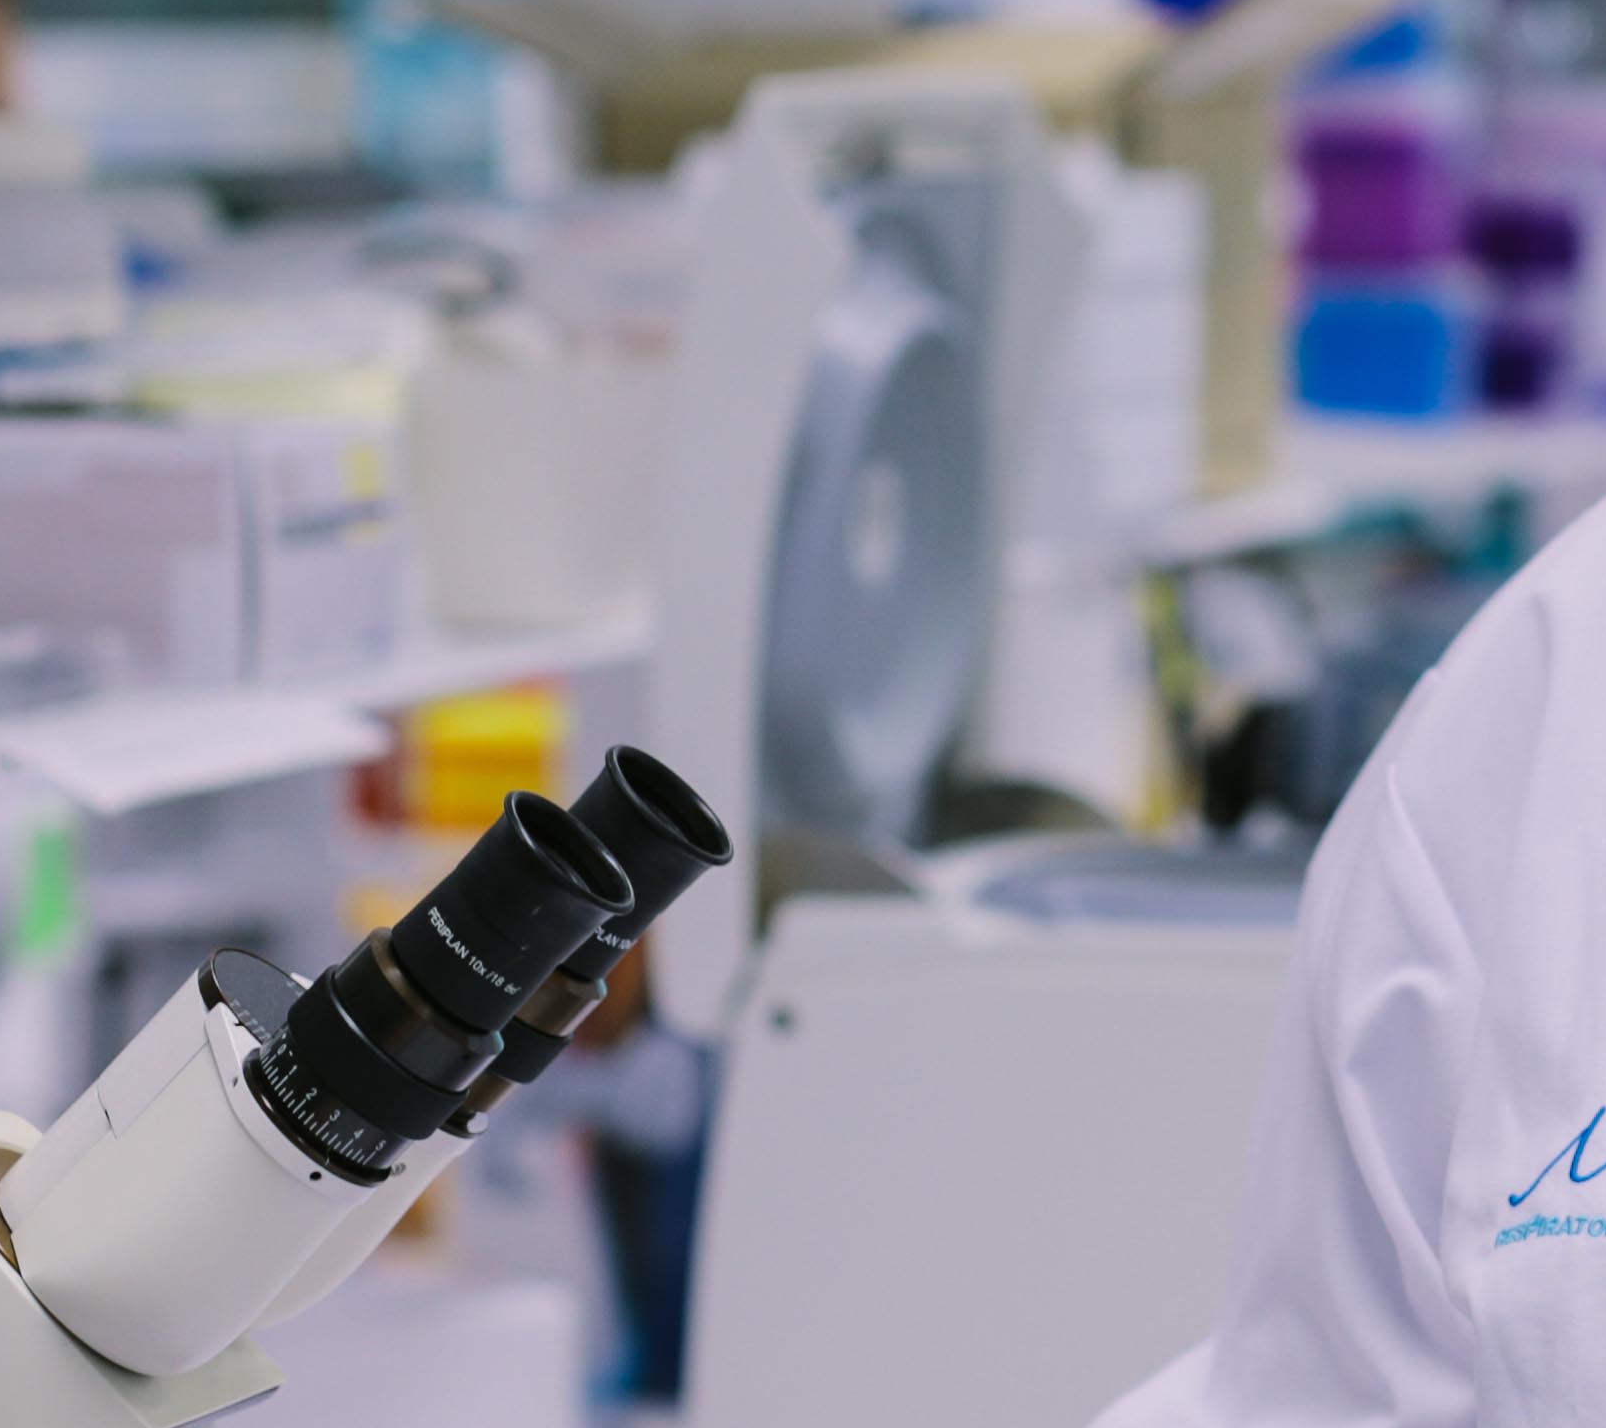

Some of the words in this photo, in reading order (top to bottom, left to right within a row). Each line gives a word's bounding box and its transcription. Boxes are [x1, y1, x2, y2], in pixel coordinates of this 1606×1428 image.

[427, 905, 470, 960] PERIPLAN
[468, 955, 488, 977] 10x
[594, 925, 621, 948] PLAN
[305, 1087, 319, 1101] 2
[329, 1109, 342, 1122] 3
[352, 1128, 366, 1140] 4
[375, 1139, 388, 1152] 5
